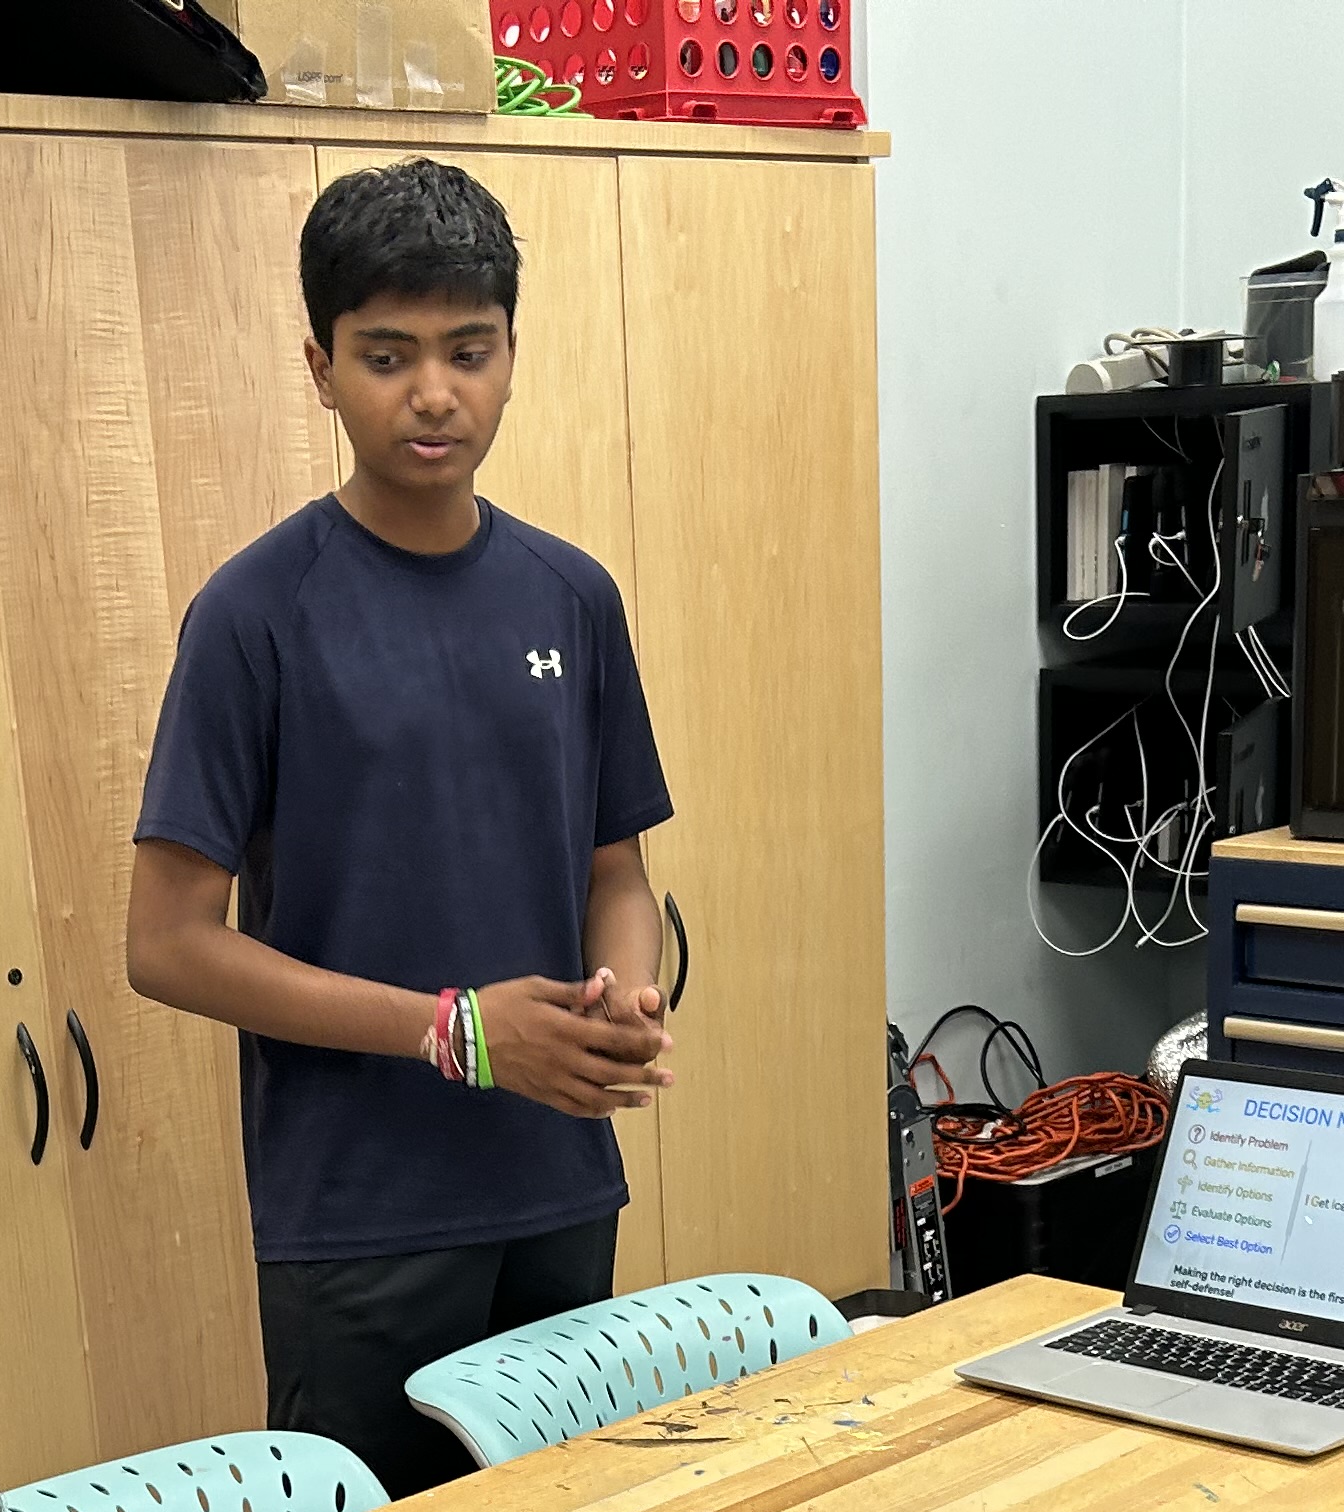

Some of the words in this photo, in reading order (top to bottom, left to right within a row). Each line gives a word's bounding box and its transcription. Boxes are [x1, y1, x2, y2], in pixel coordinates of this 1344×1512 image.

[1244, 1099, 1334, 1128] DECISION
[1210, 1130, 1247, 1147] Identify
[1248, 1136, 1289, 1151] Problem
[1203, 1156, 1237, 1171] Gather
[1237, 1160, 1296, 1179] Information
[1197, 1180, 1234, 1197] Identify
[1235, 1186, 1274, 1202] Options
[1305, 1194, 1311, 1206] I
[1311, 1195, 1330, 1209] Get
[1191, 1206, 1233, 1222] Evaluate
[1234, 1213, 1273, 1229] Options
[1185, 1230, 1216, 1245] Select
[1217, 1236, 1239, 1249] Best
[1240, 1240, 1273, 1255] Option
[1170, 1278, 1235, 1299] self-defense!
[1174, 1264, 1208, 1281] Making
[1210, 1271, 1227, 1284] the
[1228, 1275, 1253, 1290] right
[1254, 1279, 1296, 1297] decision
[1298, 1287, 1307, 1298] is
[1309, 1288, 1326, 1301] the
[1278, 1319, 1309, 1332] acer
